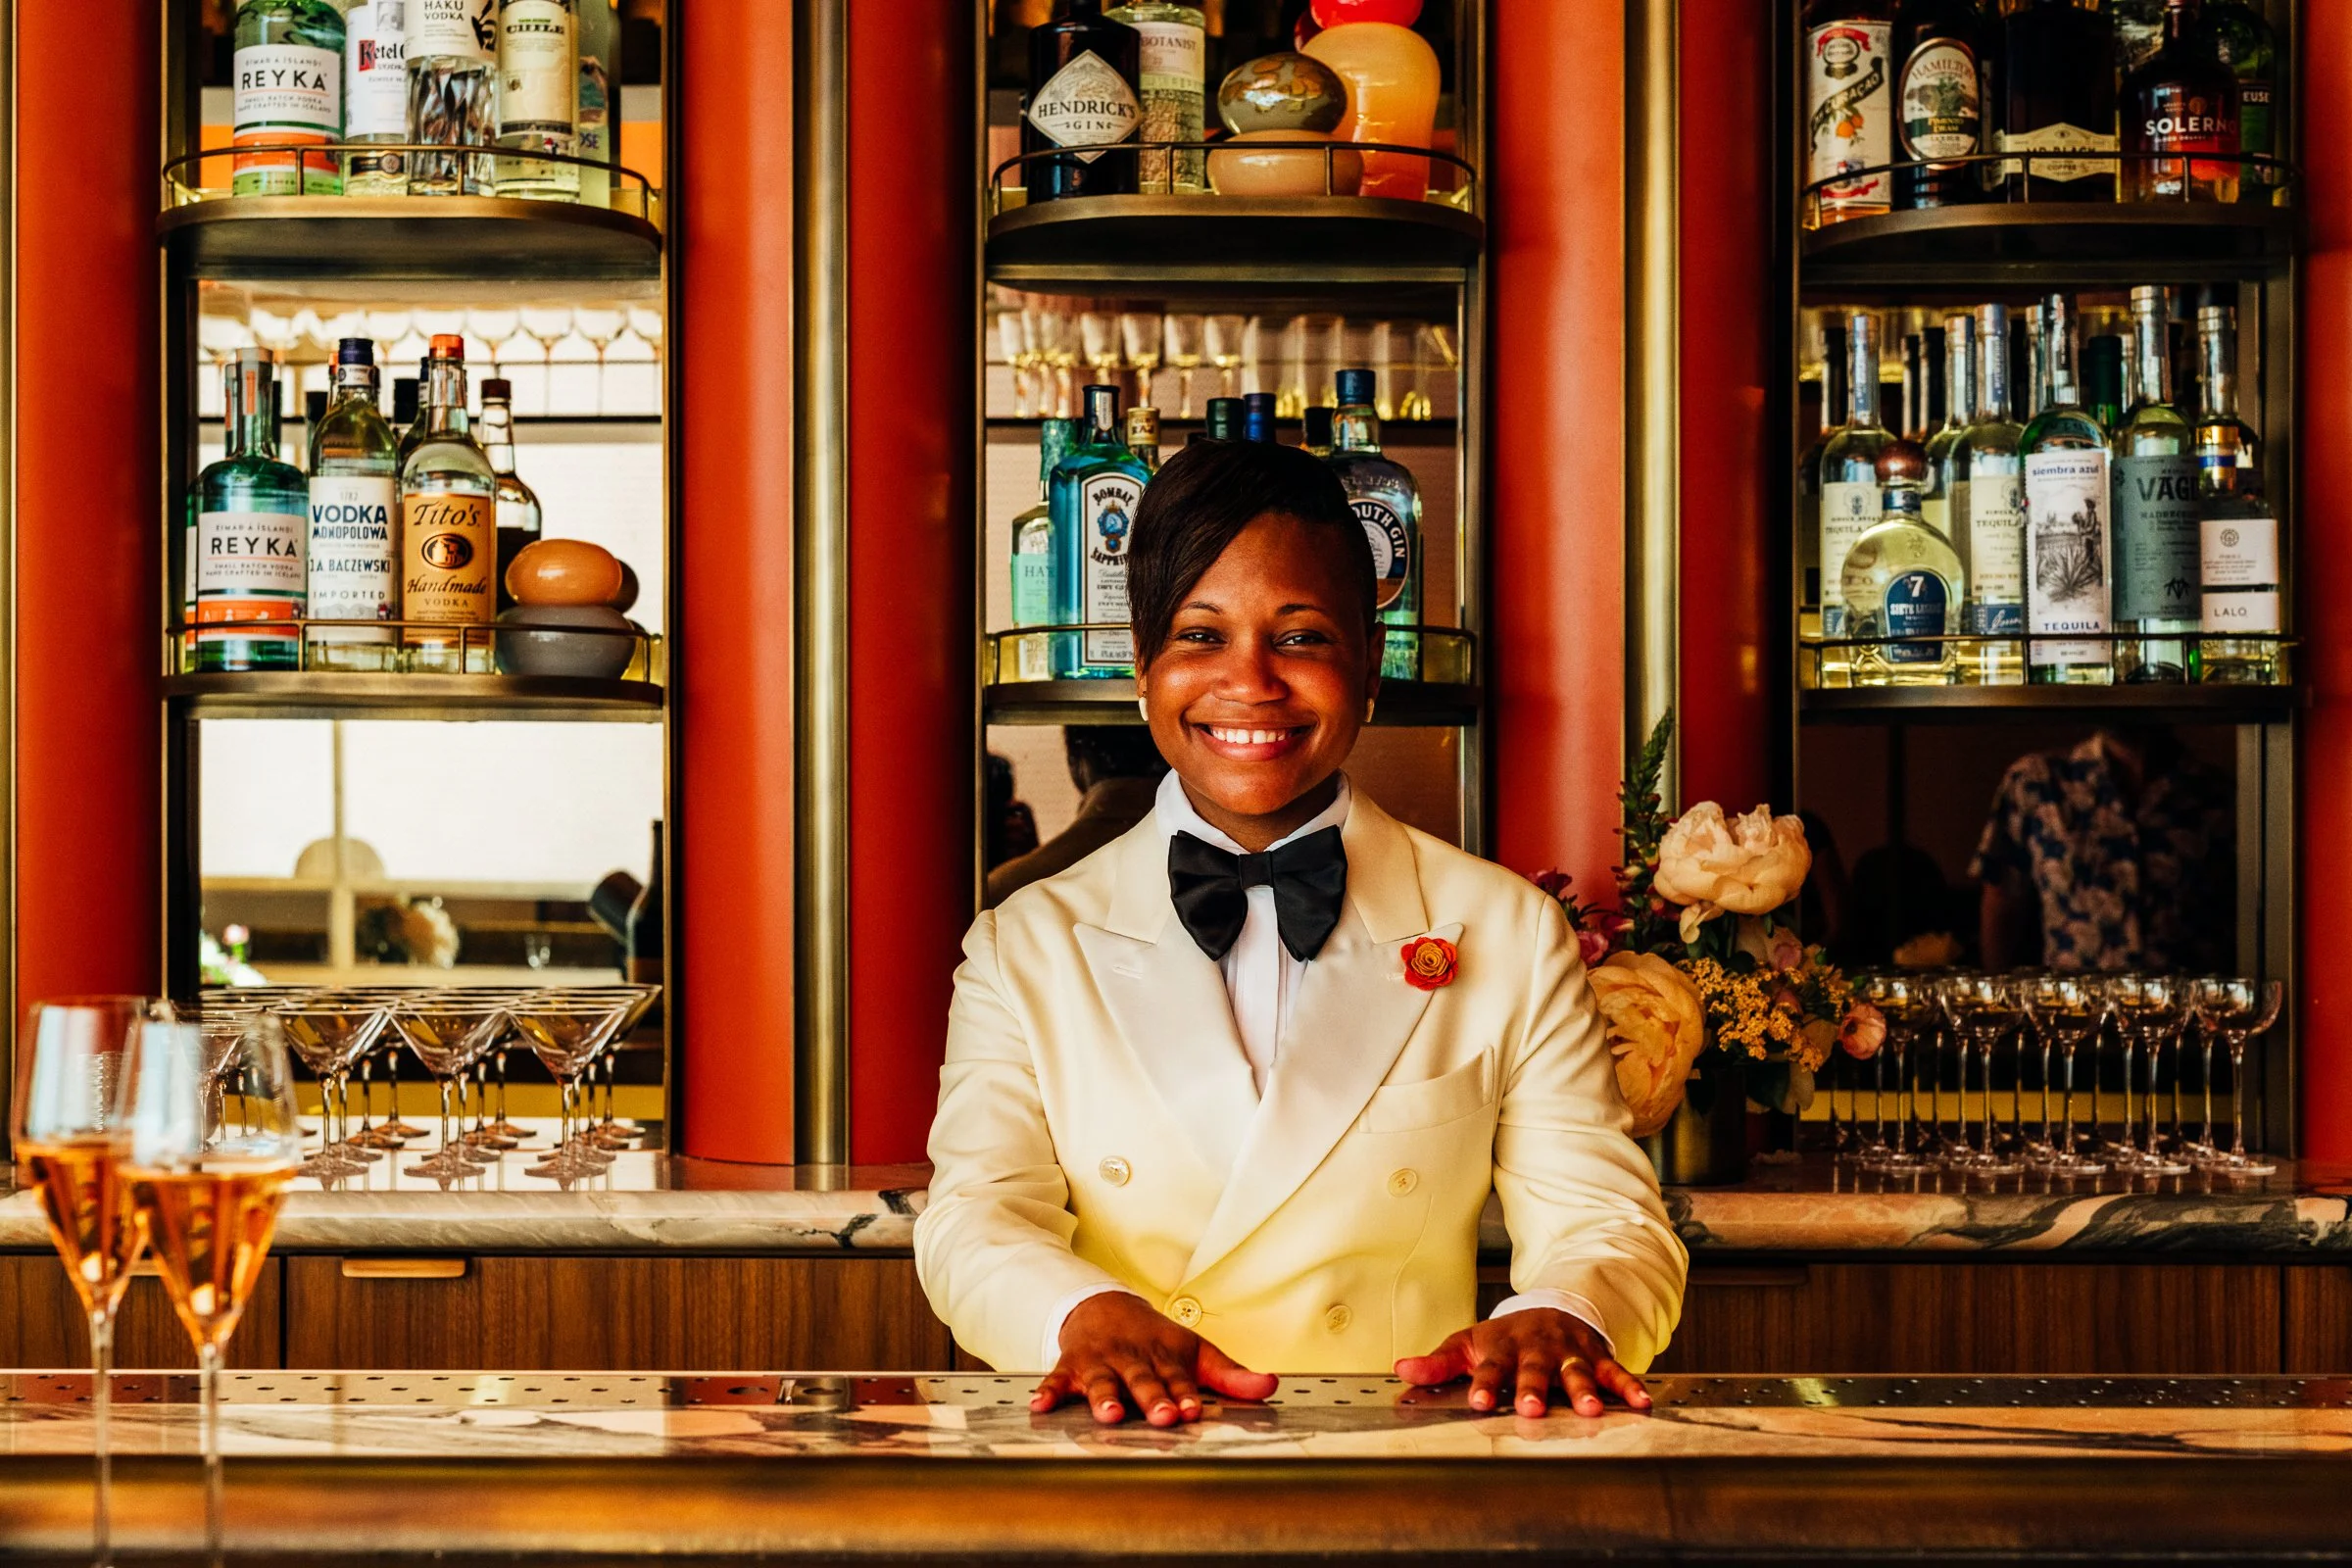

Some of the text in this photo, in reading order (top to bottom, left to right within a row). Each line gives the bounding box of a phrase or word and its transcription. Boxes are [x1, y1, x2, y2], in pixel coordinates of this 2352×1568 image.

[424, 0, 464, 11] HAKU
[424, 12, 464, 21] VODKA
[1141, 36, 1198, 50] BOTANIST
[360, 42, 396, 66] Ketel
[242, 70, 325, 91] REYKA
[1039, 100, 1135, 119] HENDRICK'S
[1073, 121, 1105, 129] GIN
[2145, 117, 2236, 136] SOLERNO
[2033, 466, 2076, 476] siembra
[1093, 487, 1134, 507] BOMBAY
[313, 505, 387, 524] VODKA
[414, 501, 478, 526] Tito's
[312, 526, 387, 540] MONOPOLOWA
[211, 537, 297, 558] REYKA
[1390, 527, 1405, 558] GIN
[329, 559, 390, 573] BACZEWSKI
[407, 574, 487, 595] Handmade
[1910, 576, 1925, 598] 7
[314, 591, 385, 600] IMPORTED
[424, 598, 468, 607] VODKA
[2214, 607, 2246, 617] LALO
[2044, 621, 2099, 630] TEQUILA
